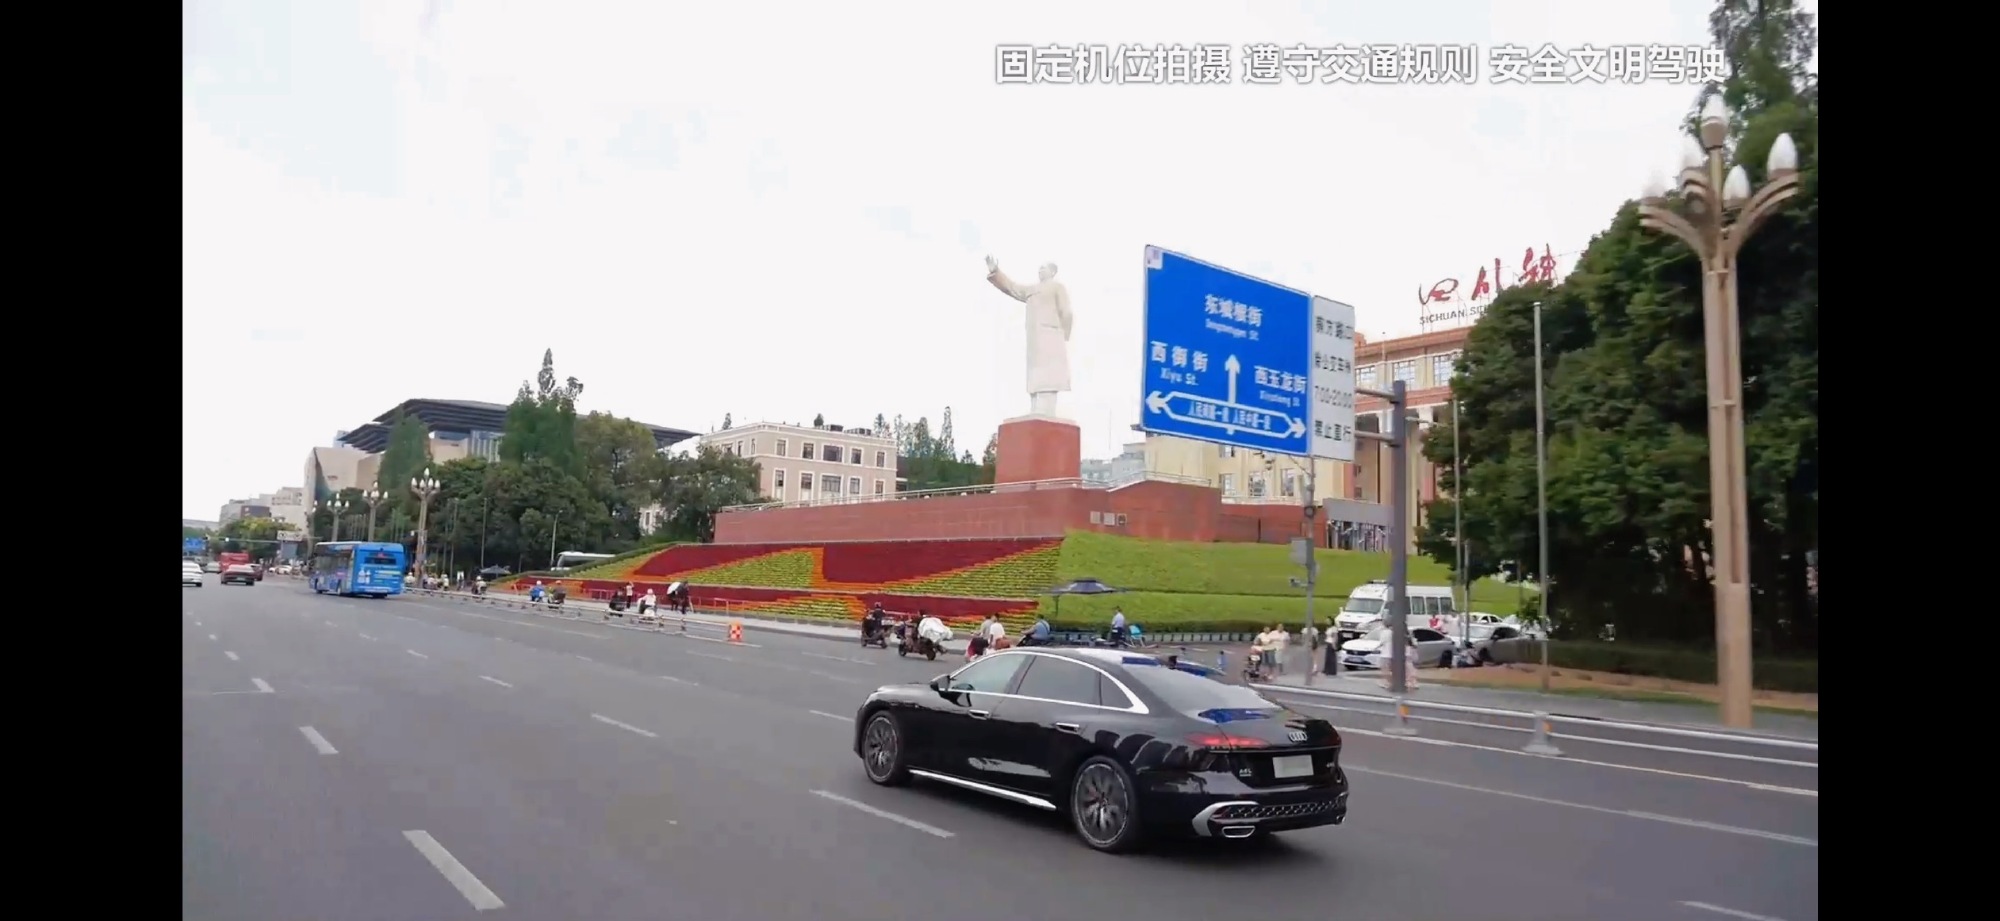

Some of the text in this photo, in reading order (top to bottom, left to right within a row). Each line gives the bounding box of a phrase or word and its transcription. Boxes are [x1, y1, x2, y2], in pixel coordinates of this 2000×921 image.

[1420, 309, 1465, 325] SICHUAN
[1150, 340, 1208, 373] 西御街
[1253, 365, 1307, 394] 西玉龙街
